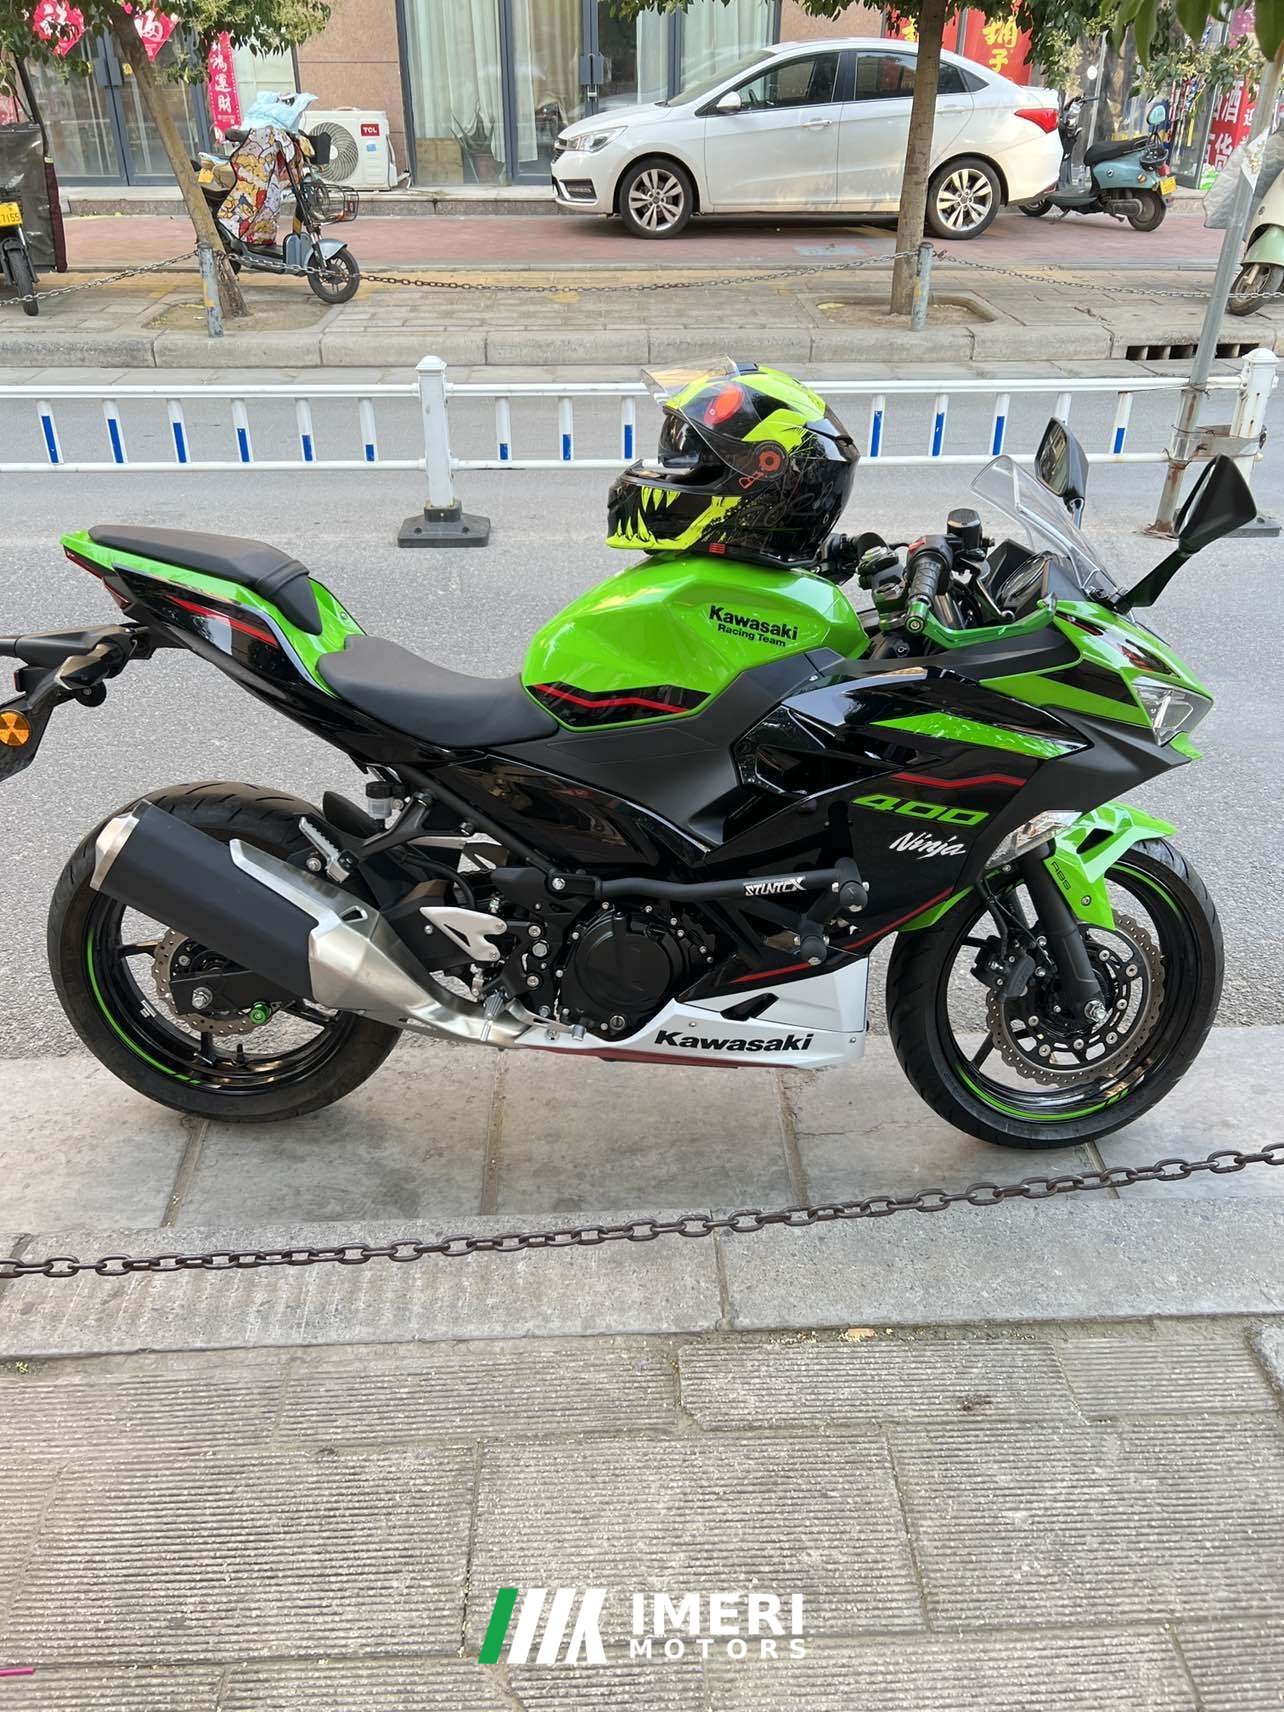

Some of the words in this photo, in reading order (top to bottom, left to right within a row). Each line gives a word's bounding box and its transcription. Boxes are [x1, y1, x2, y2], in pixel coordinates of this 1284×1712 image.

[708, 604, 799, 641] Kawasaki
[717, 622, 756, 641] Racing
[757, 633, 787, 648] Team
[852, 794, 990, 826] 400
[888, 831, 967, 860] Ninja
[1051, 860, 1072, 891] ABS
[654, 1029, 815, 1053] Kawasaki
